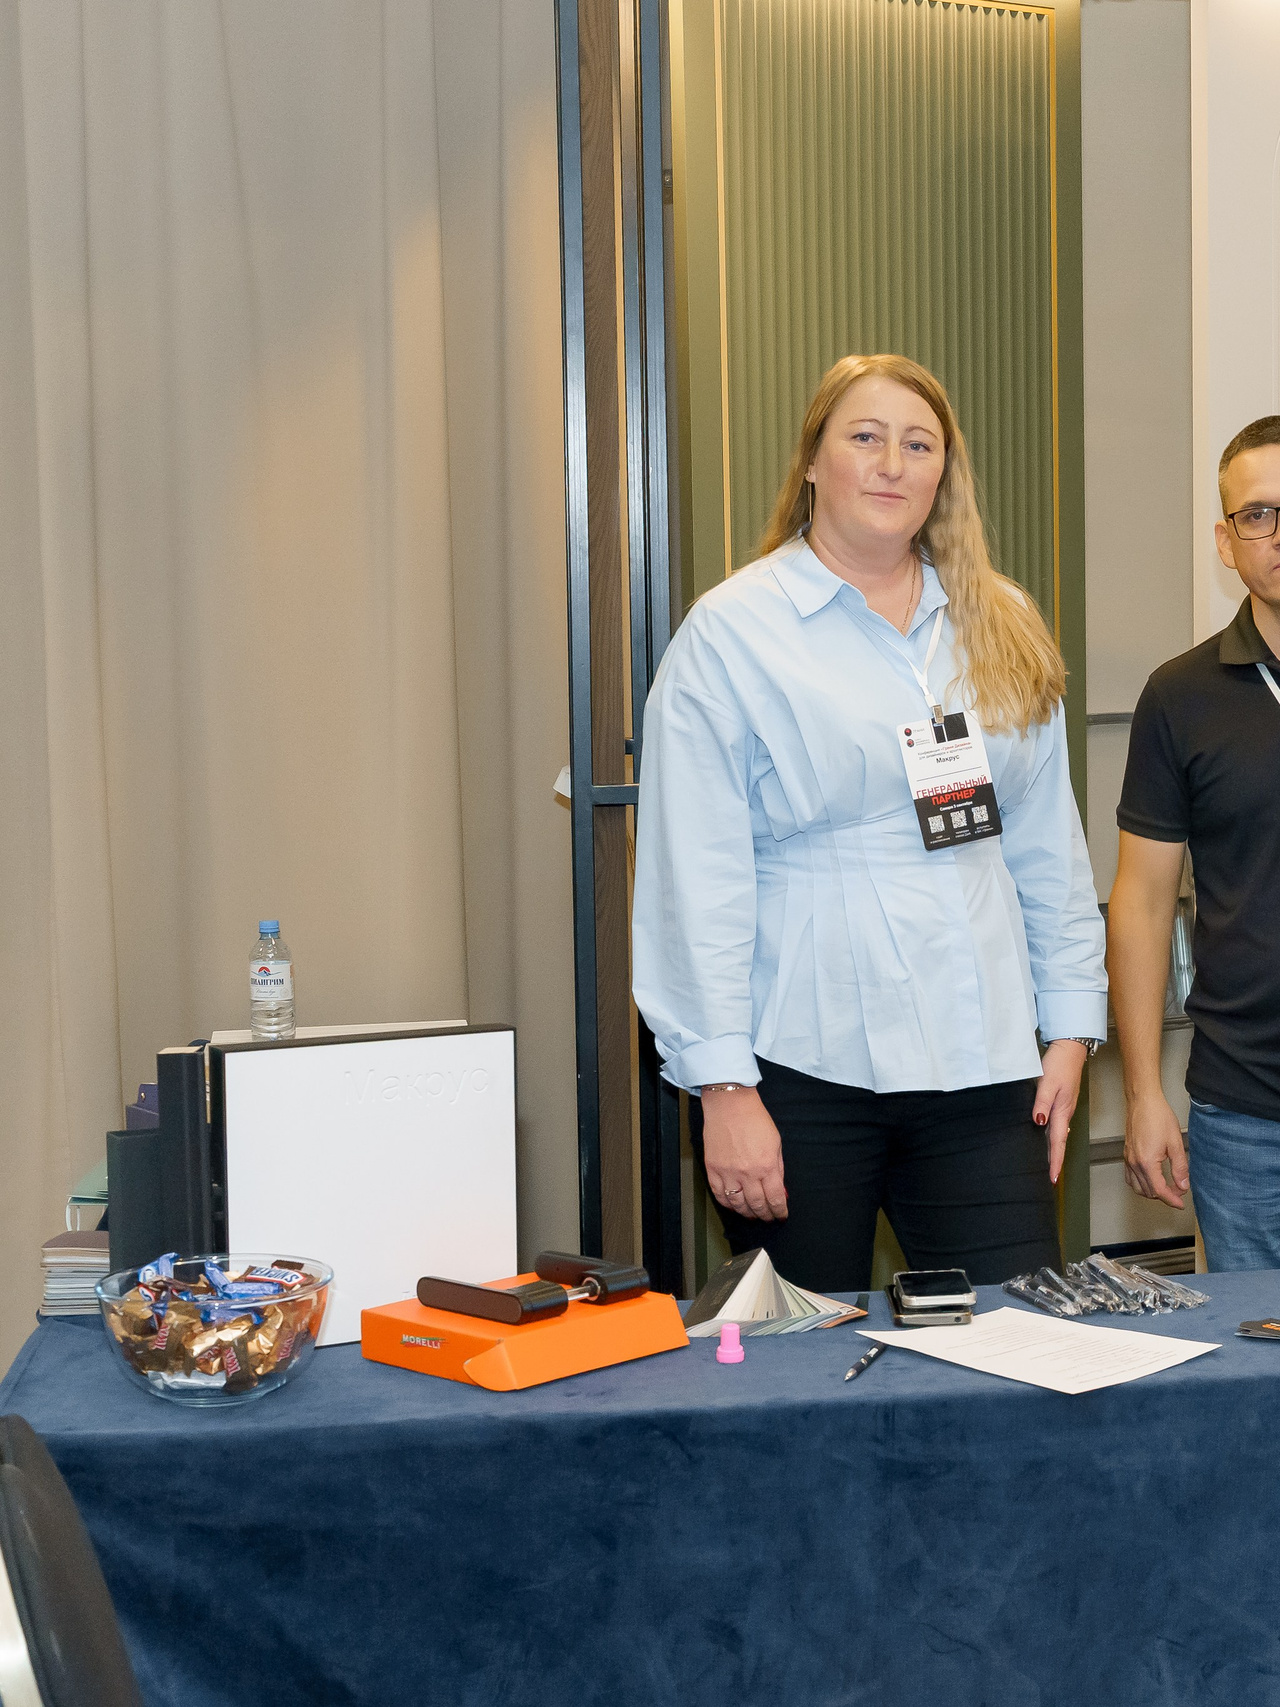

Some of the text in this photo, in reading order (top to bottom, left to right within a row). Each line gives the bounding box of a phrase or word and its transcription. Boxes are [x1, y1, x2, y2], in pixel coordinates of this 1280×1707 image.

[936, 755, 960, 764] Макрус
[916, 775, 988, 799] ГЕНЕРАЛЬНЫЙ
[931, 788, 976, 806] ПАРТНЕР
[344, 1067, 489, 1107] Макрус
[402, 1334, 440, 1349] MORELLI
